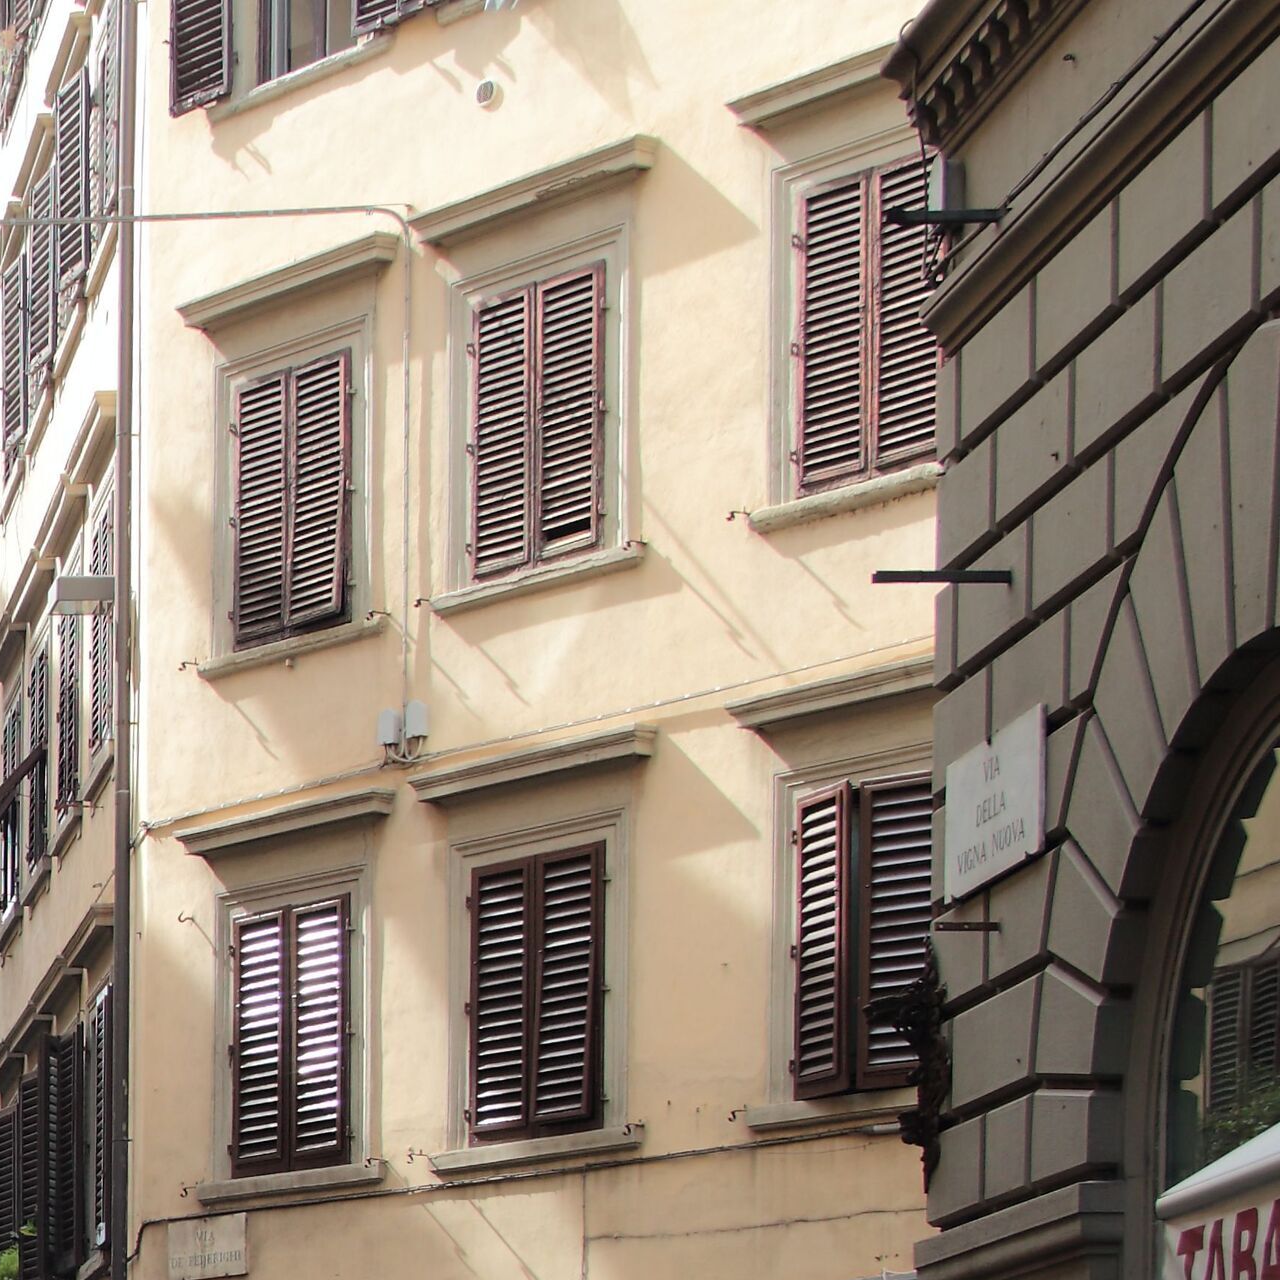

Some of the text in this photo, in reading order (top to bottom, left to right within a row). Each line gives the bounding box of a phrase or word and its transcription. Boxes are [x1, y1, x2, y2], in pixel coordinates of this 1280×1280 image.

[983, 755, 1000, 782] VIA
[976, 791, 1006, 828] DELLA
[957, 817, 1025, 876] VIGNA NUOVA
[195, 1230, 215, 1242] VIA
